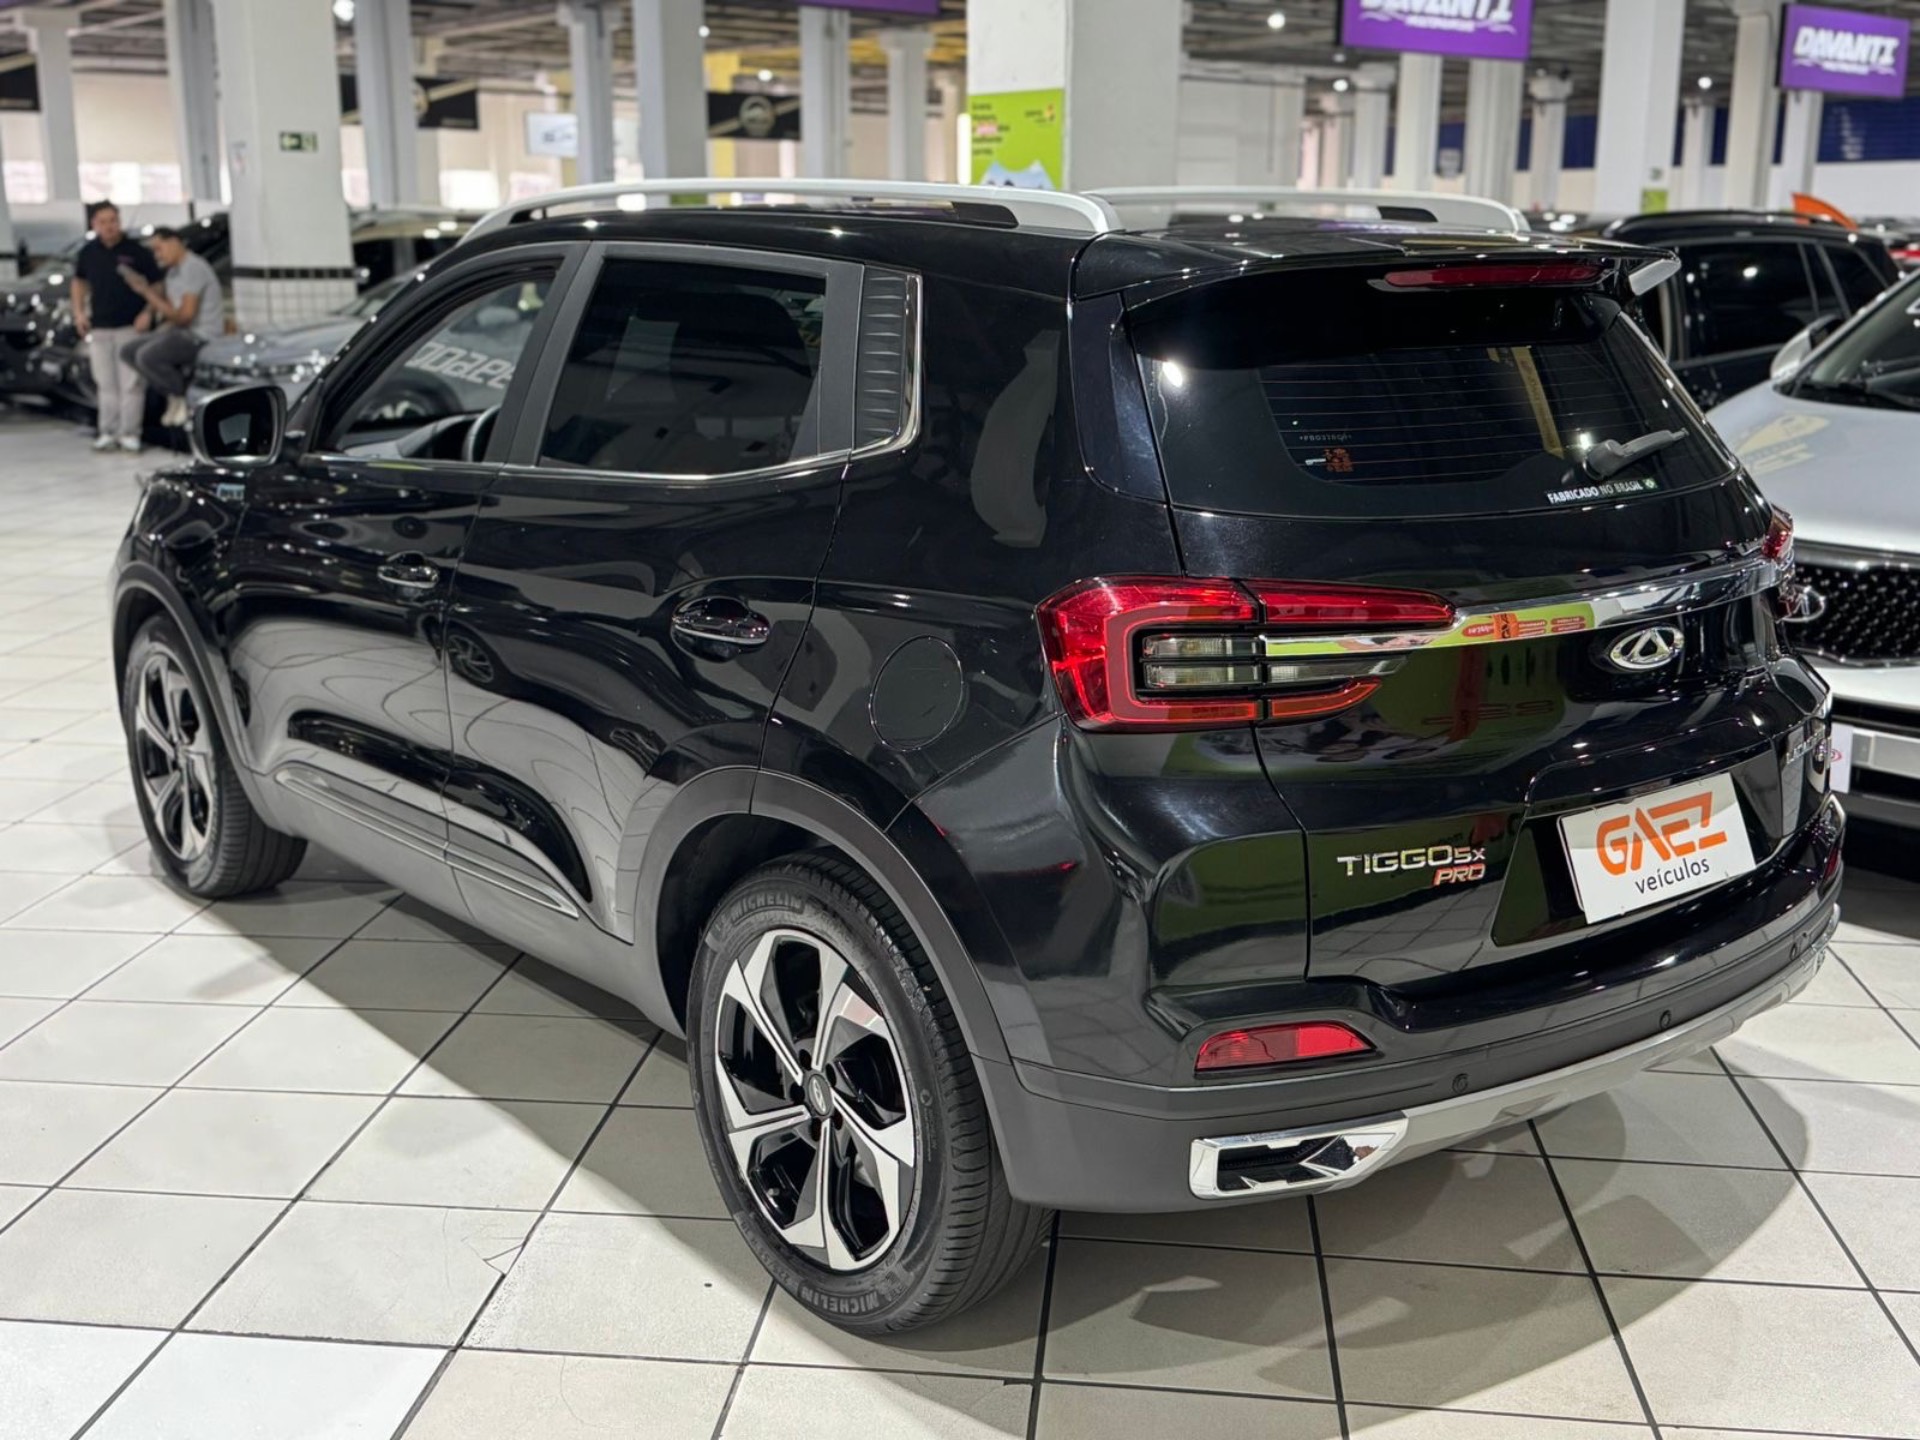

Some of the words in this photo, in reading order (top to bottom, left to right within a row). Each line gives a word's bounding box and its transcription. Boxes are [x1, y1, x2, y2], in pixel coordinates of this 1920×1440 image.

[1547, 486, 1599, 504] FABRICADO
[1599, 484, 1614, 495] NO
[1614, 480, 1643, 493] BRASIL
[1434, 863, 1486, 886] PRO
[1635, 858, 1710, 894] veículos
[731, 893, 802, 923] MICHELIN
[801, 1285, 880, 1314] MICHELIN
